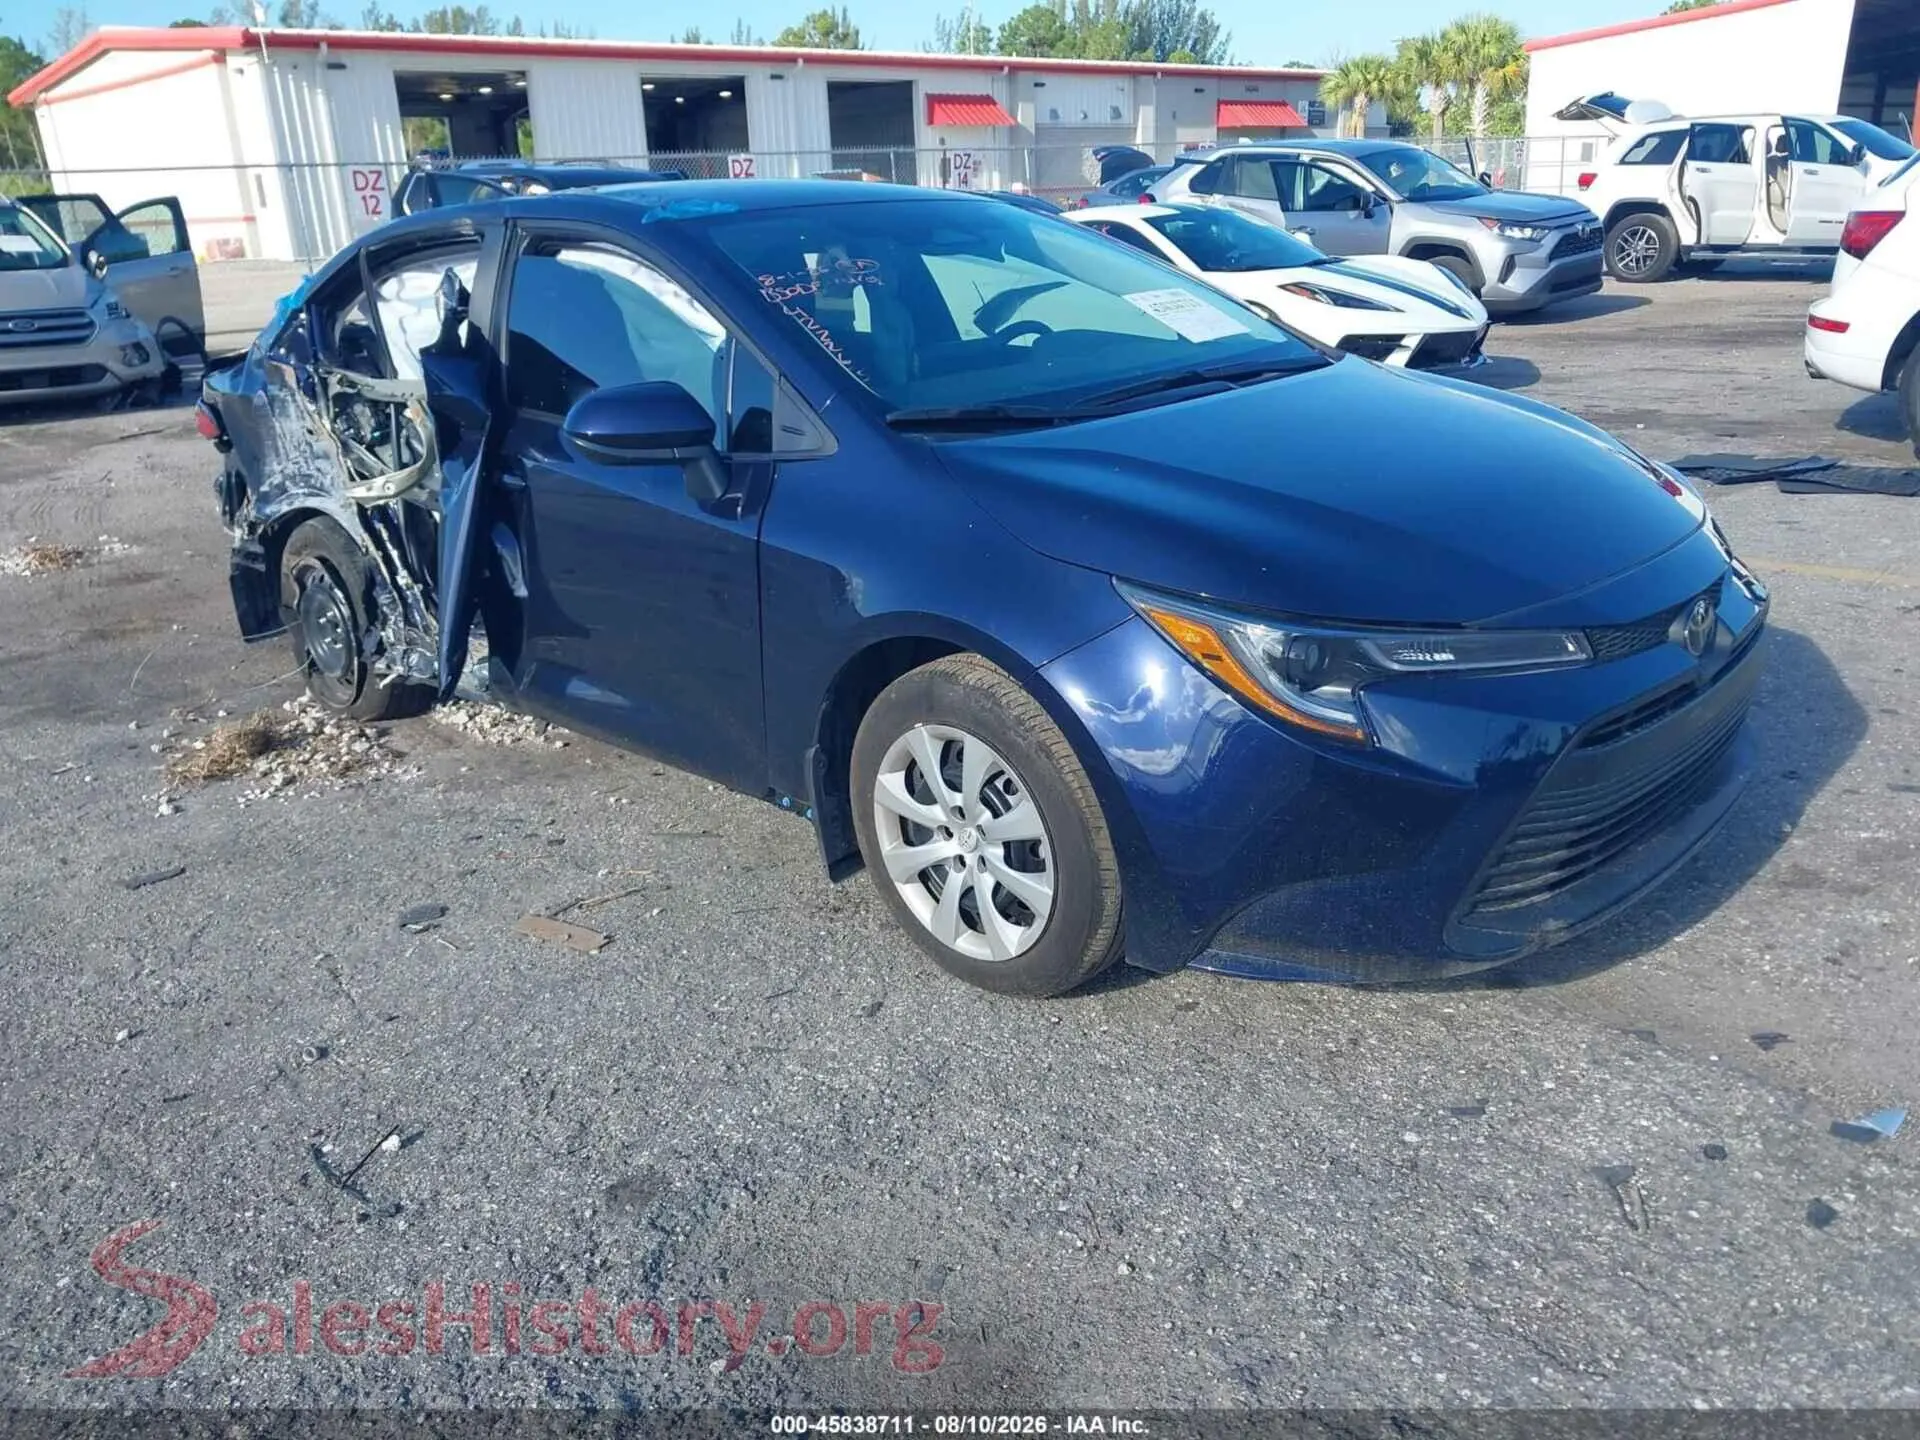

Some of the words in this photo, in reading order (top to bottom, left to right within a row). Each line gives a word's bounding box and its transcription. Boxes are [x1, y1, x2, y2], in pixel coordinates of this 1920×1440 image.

[730, 158, 756, 178] DZ
[953, 153, 972, 170] DZ
[352, 169, 385, 192] DZ
[361, 194, 383, 217] 12
